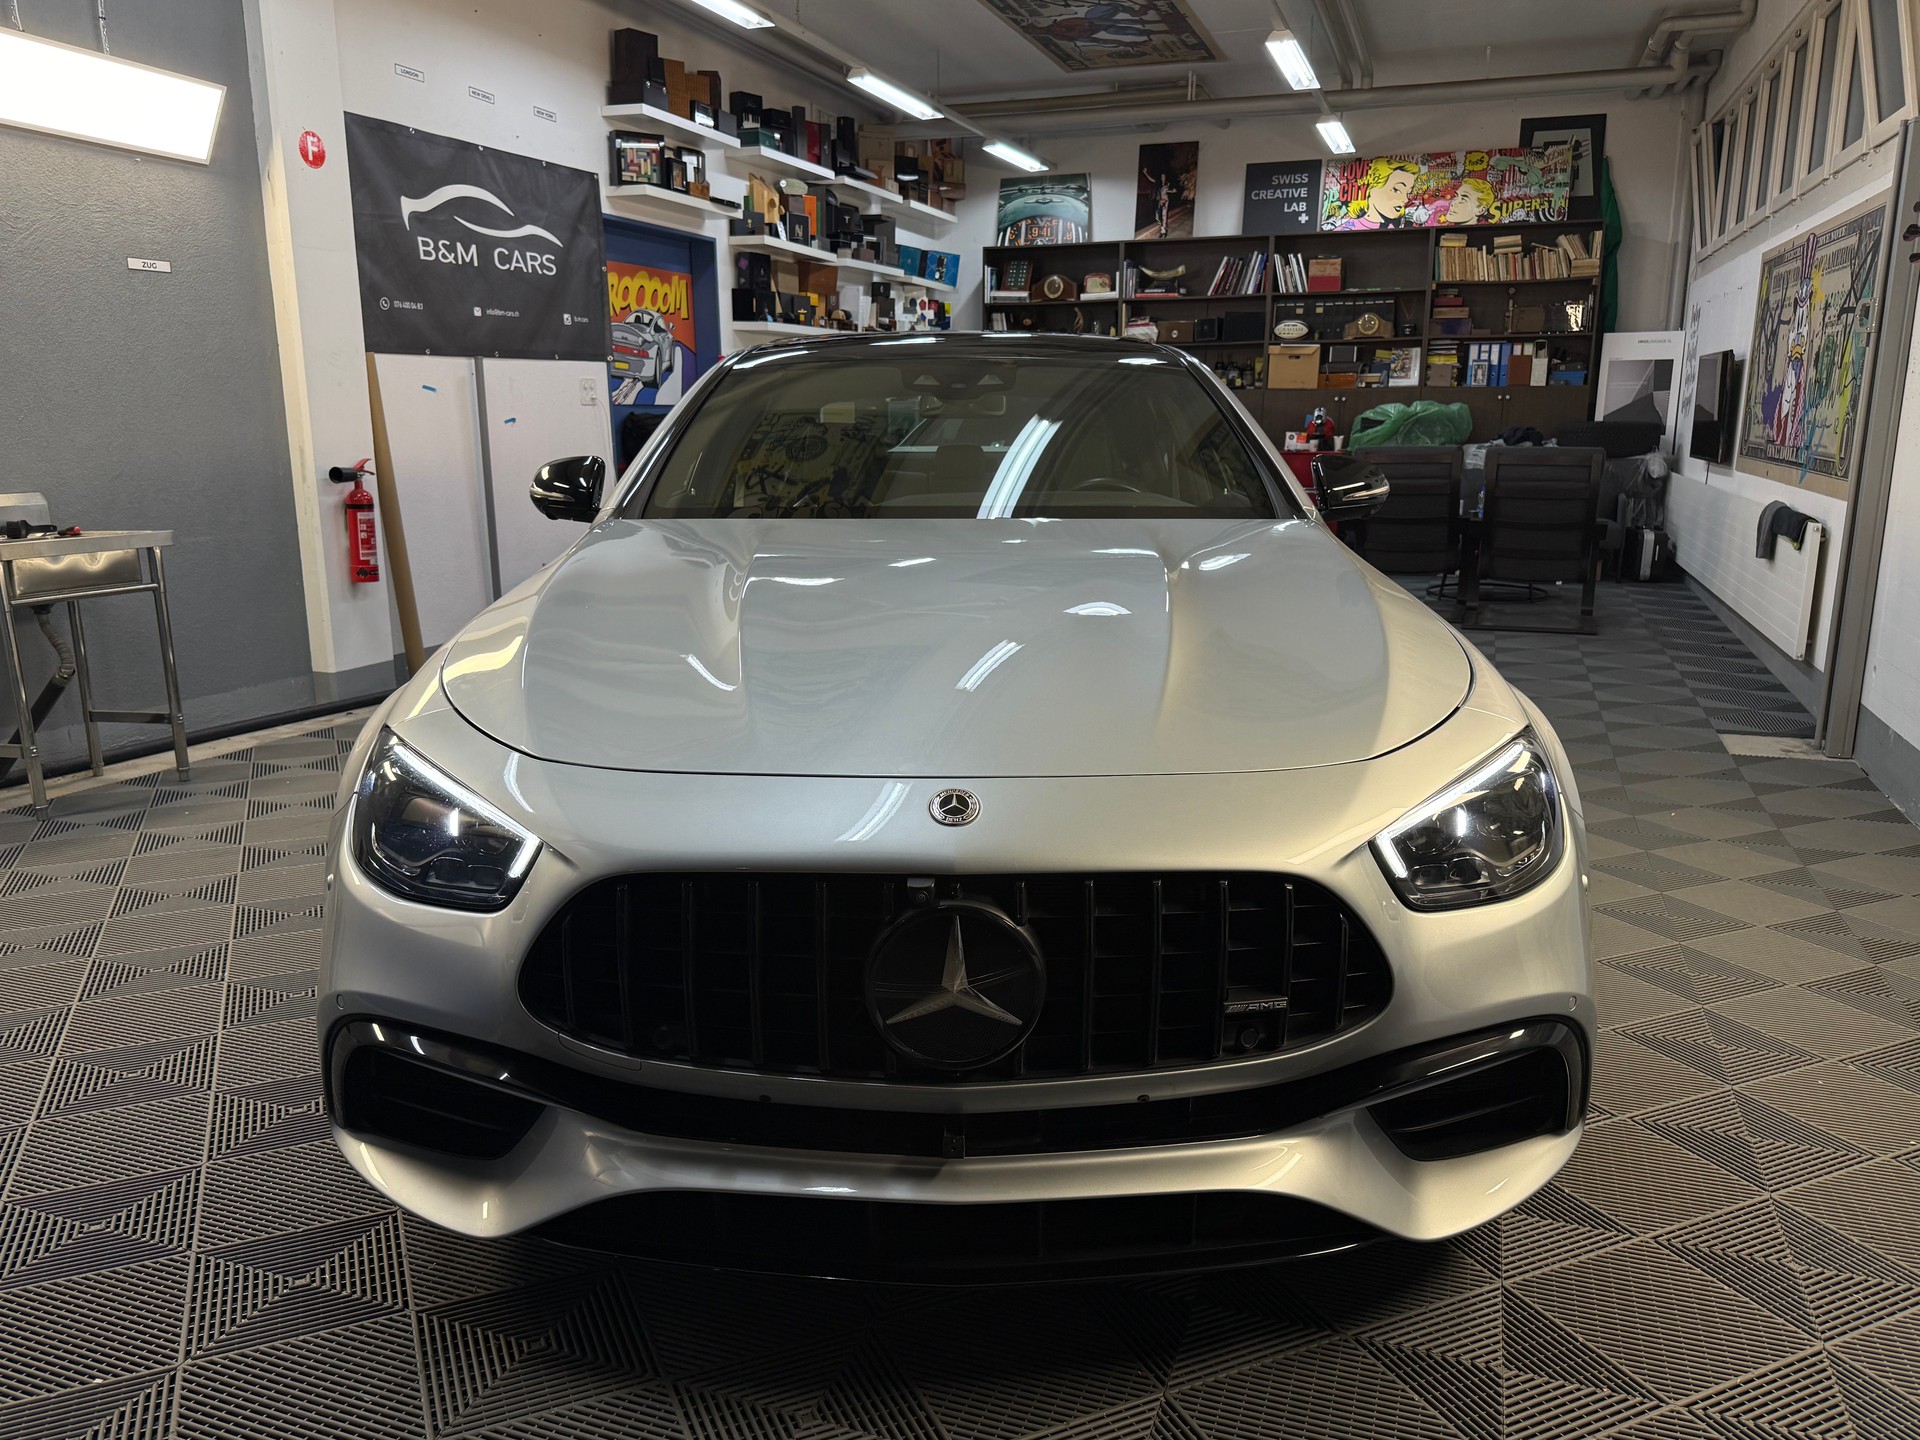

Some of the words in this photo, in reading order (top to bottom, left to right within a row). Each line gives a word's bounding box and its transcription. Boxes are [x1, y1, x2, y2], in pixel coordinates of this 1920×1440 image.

[400, 68, 419, 78] LONDON
[306, 135, 318, 161] F
[1340, 160, 1370, 180] LOVE
[1272, 173, 1309, 185] SWISS
[1251, 188, 1308, 200] CREATIVE
[1284, 202, 1307, 212] LAB
[417, 236, 478, 267] B&M
[493, 247, 557, 276] CARS
[141, 261, 157, 269] ZUG
[1780, 445, 1807, 464] DOLLR
